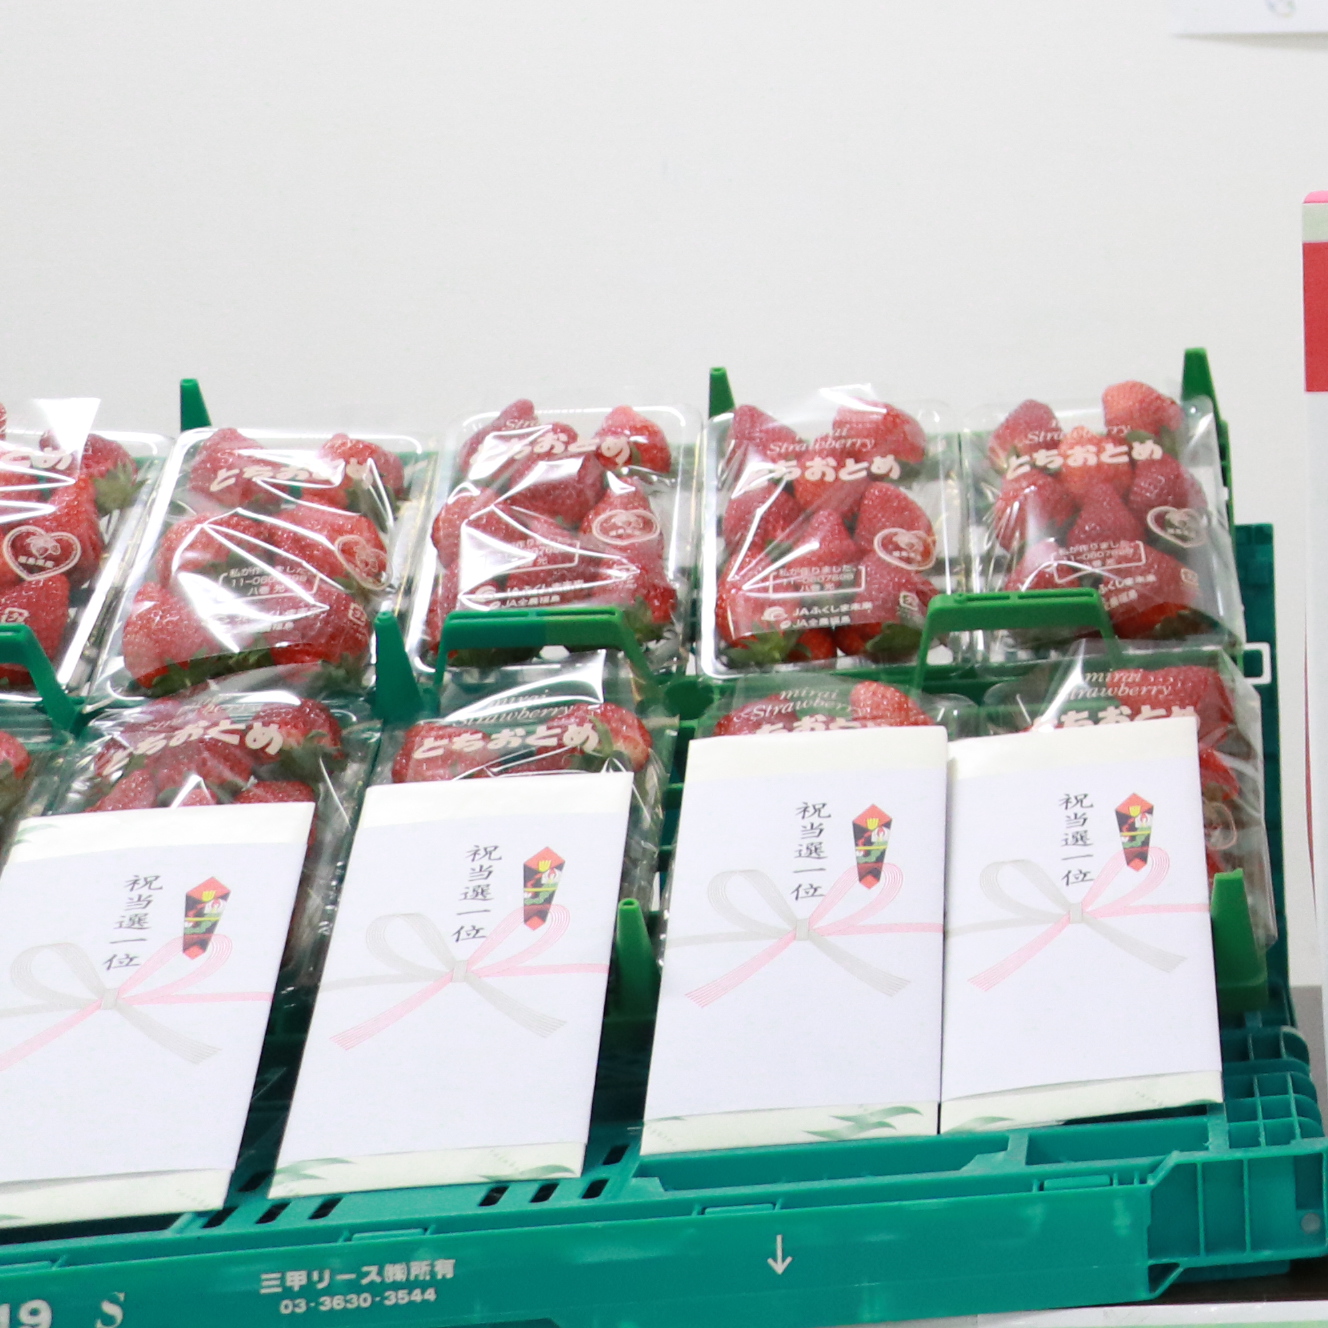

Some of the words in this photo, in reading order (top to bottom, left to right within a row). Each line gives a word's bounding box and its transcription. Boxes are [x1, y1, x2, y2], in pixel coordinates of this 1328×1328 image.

[1006, 439, 1164, 481] とちおとめ
[779, 685, 839, 701] mirai
[1085, 668, 1143, 683] mirai
[412, 722, 600, 760] とちおとめ
[790, 801, 832, 900] 祝当選一位
[1058, 791, 1095, 886] 祝当選一位
[452, 843, 503, 944] 祝当選一位
[104, 874, 163, 971] 祝当選一位
[280, 1287, 437, 1315] 03-3630-3544
